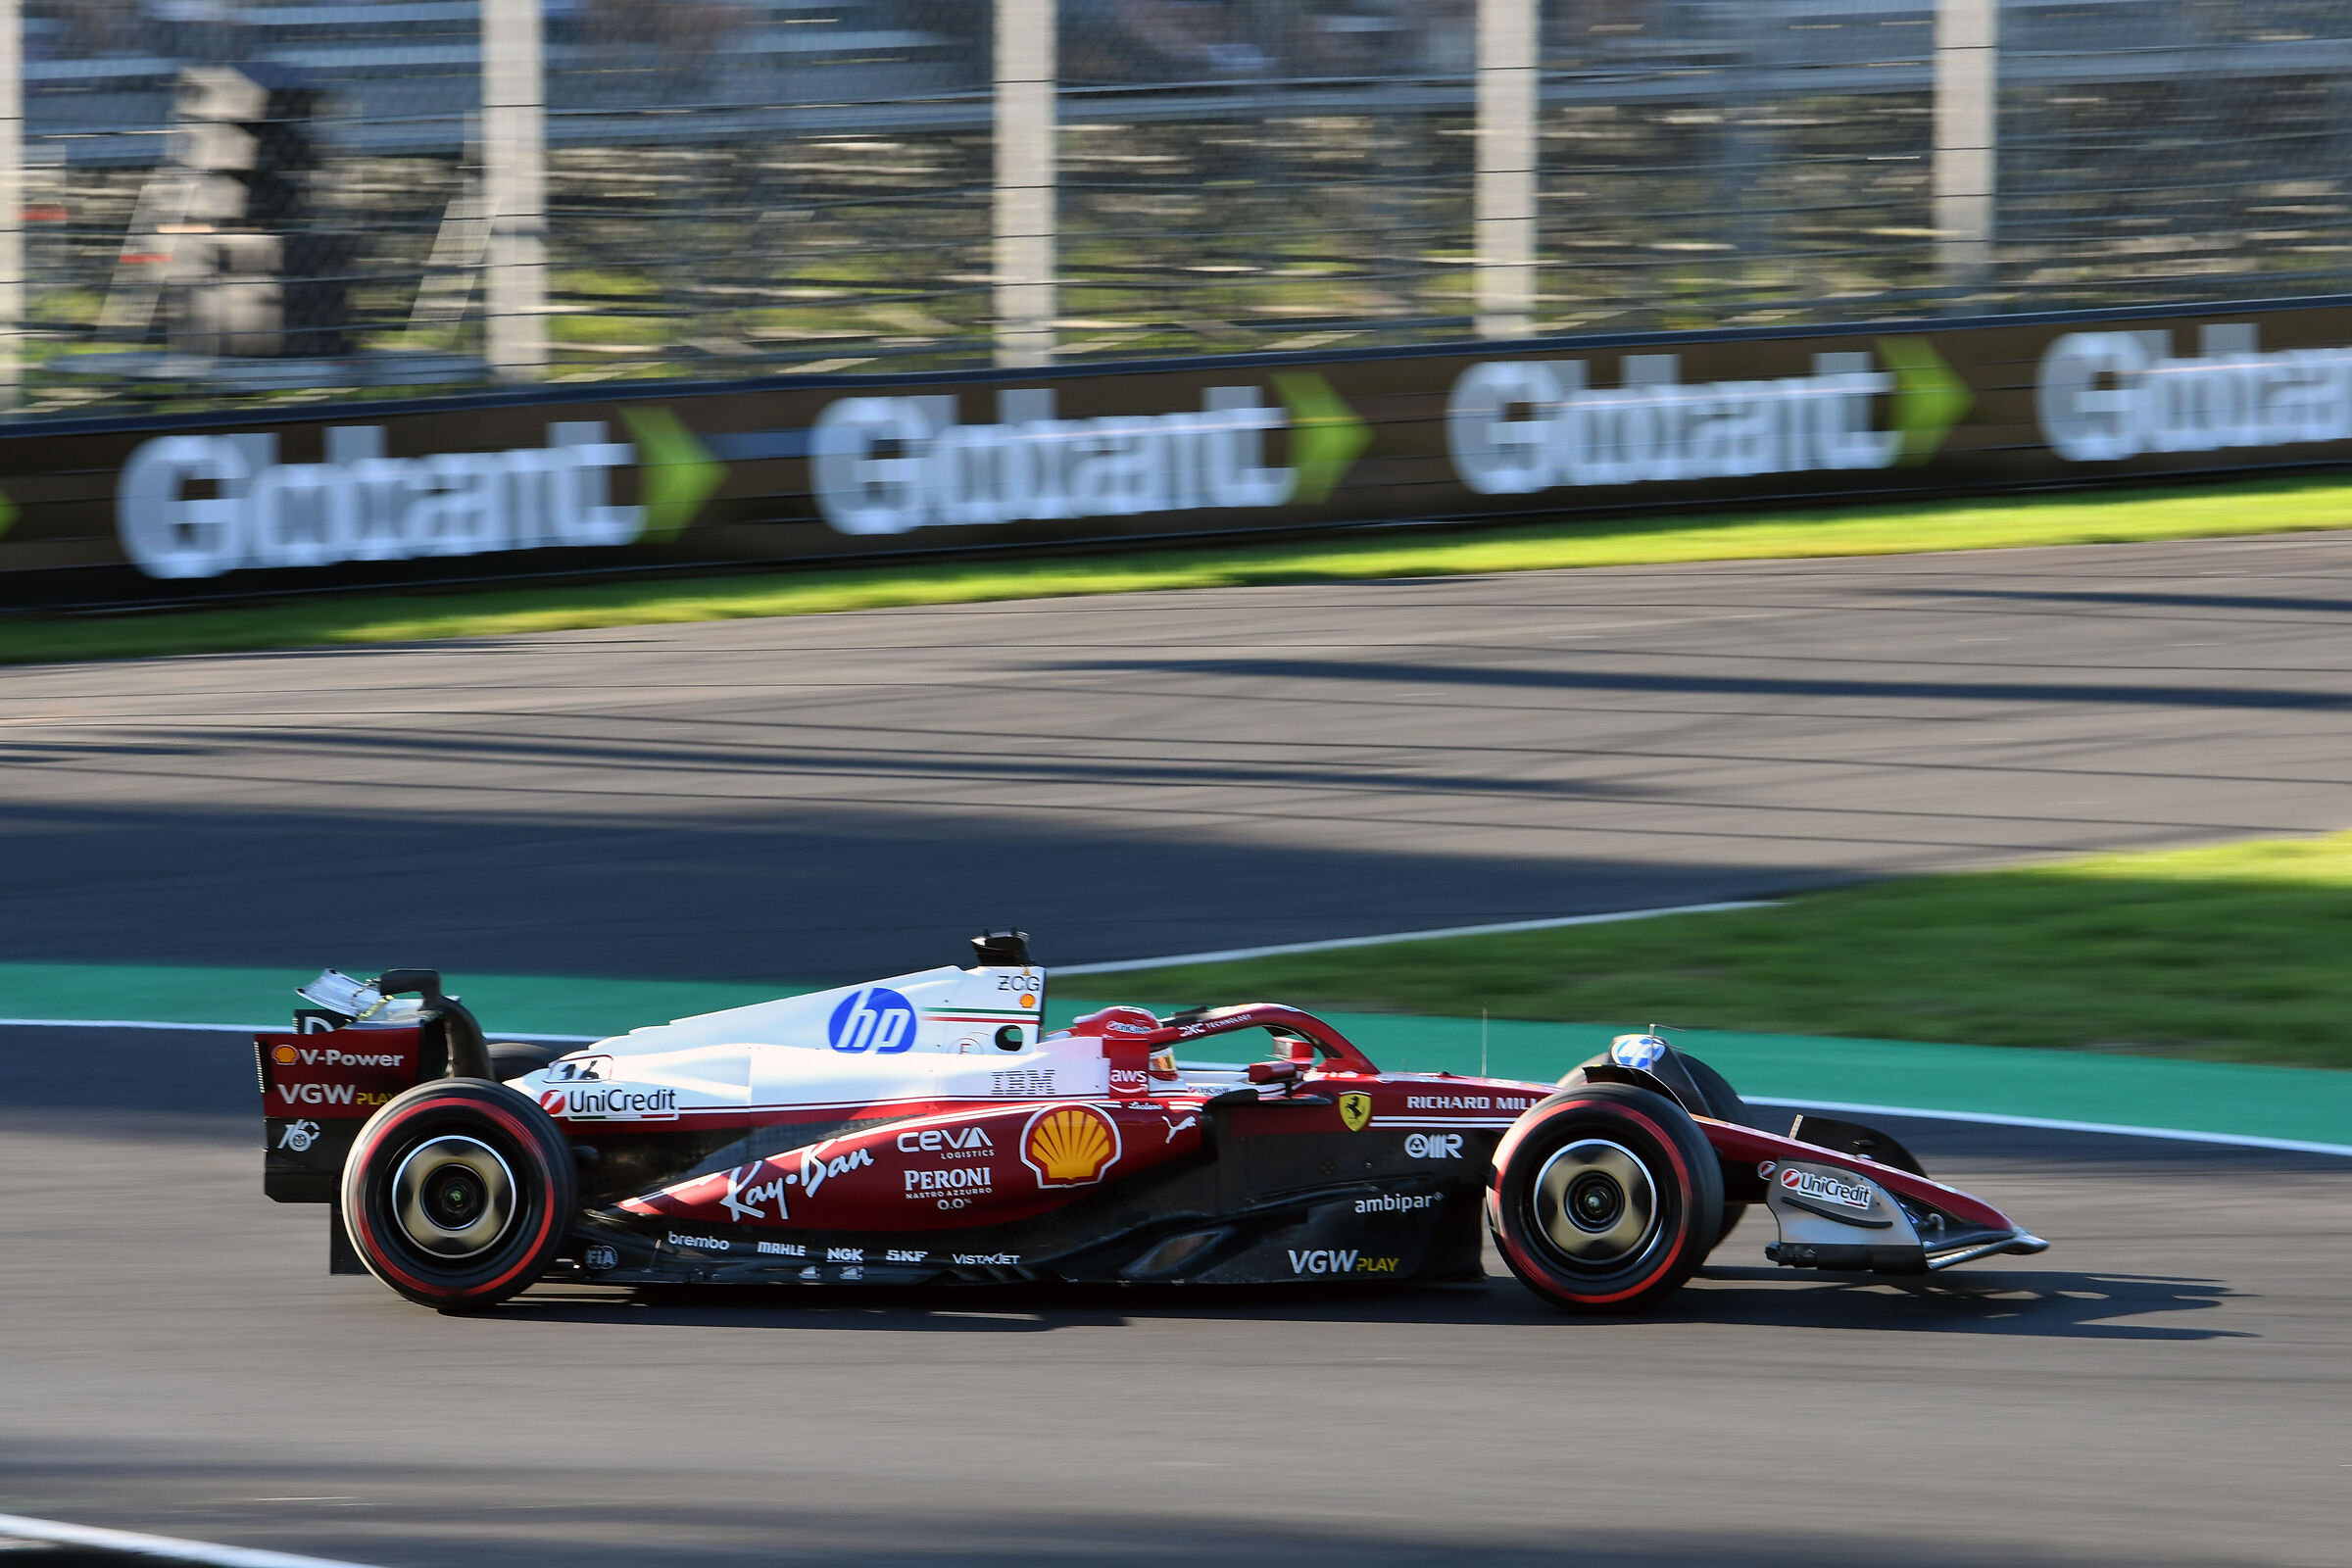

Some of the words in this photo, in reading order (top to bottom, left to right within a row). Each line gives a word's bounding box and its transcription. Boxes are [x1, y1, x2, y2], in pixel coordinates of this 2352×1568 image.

[835, 988, 911, 1054] hp
[1204, 1013, 1252, 1029] TECHNOLOGY
[299, 1050, 404, 1067] V-Power
[561, 1060, 599, 1080] 16
[1111, 1070, 1147, 1083] aws
[991, 1069, 1055, 1096] IBM
[277, 1084, 356, 1104] VGW
[570, 1089, 676, 1112] UniCredit
[1406, 1096, 1491, 1109] RICHARD
[941, 1149, 995, 1160] LOGISTICS
[719, 1138, 875, 1222] Ray-Ban
[904, 1167, 992, 1191] PERONI
[1801, 1173, 1869, 1202] UniCredit
[905, 1191, 945, 1200] NASTRO
[947, 1187, 993, 1197] AZZURRO
[668, 1231, 730, 1250] brembo
[758, 1241, 806, 1256] MAHLE
[827, 1248, 863, 1261] NGK
[886, 1250, 928, 1262] SKF
[1288, 1250, 1358, 1274] VGW
[1356, 1257, 1399, 1272] PLAY
